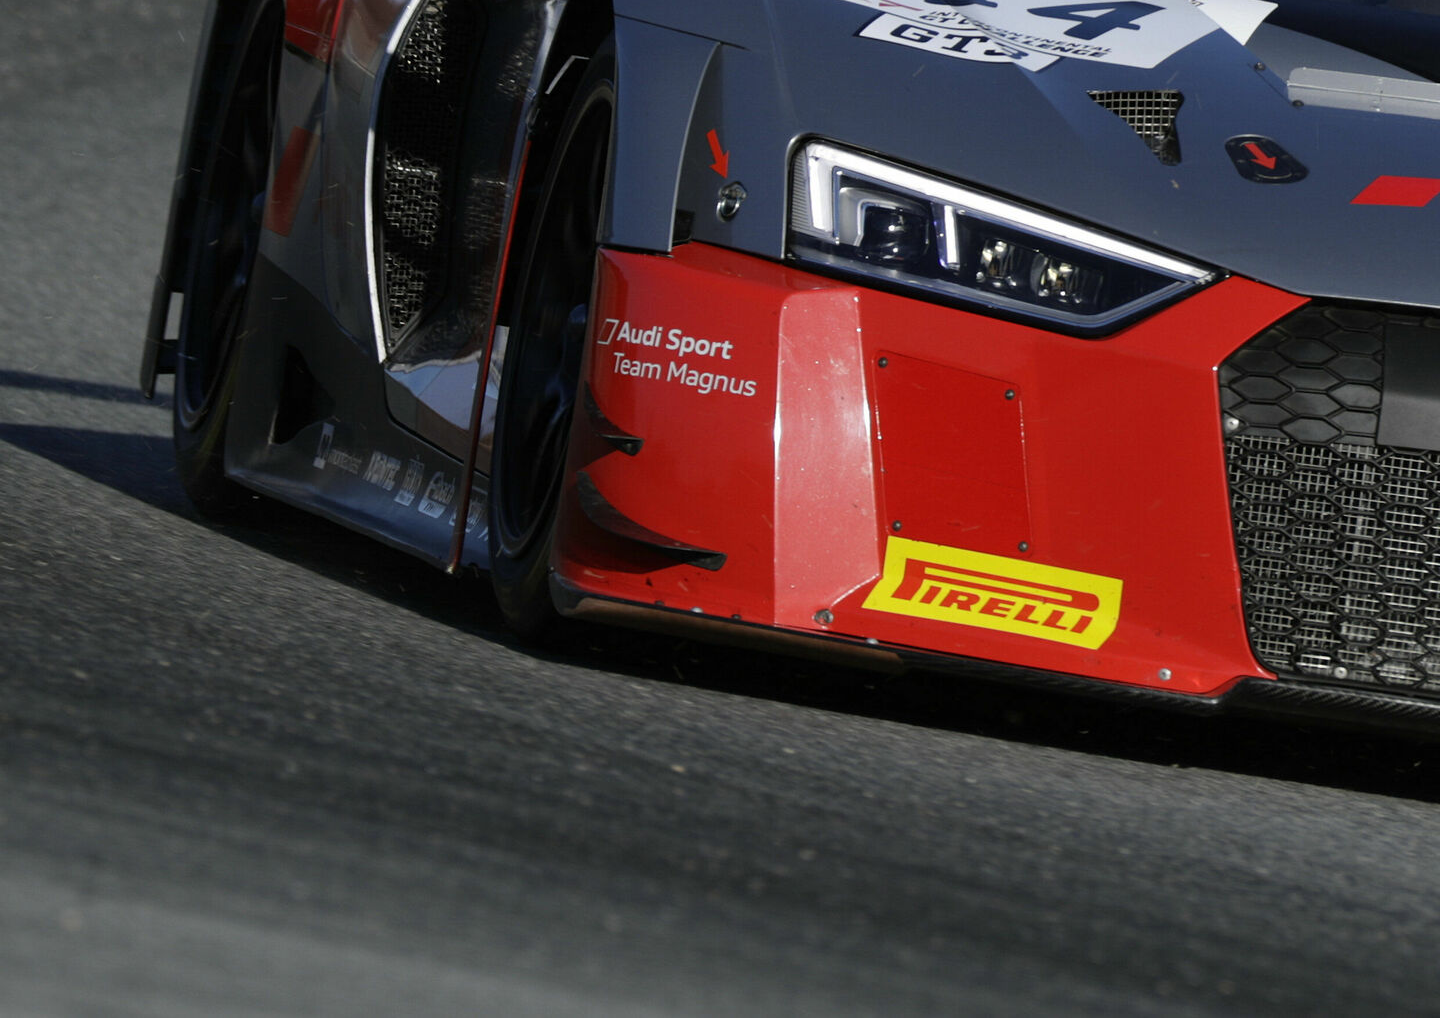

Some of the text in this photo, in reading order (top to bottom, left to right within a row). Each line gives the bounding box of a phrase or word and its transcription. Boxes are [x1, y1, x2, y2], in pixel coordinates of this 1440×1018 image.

[616, 321, 733, 360] Audi Sport
[613, 352, 758, 397] Team Magnus
[891, 558, 1100, 634] PIRELLI
